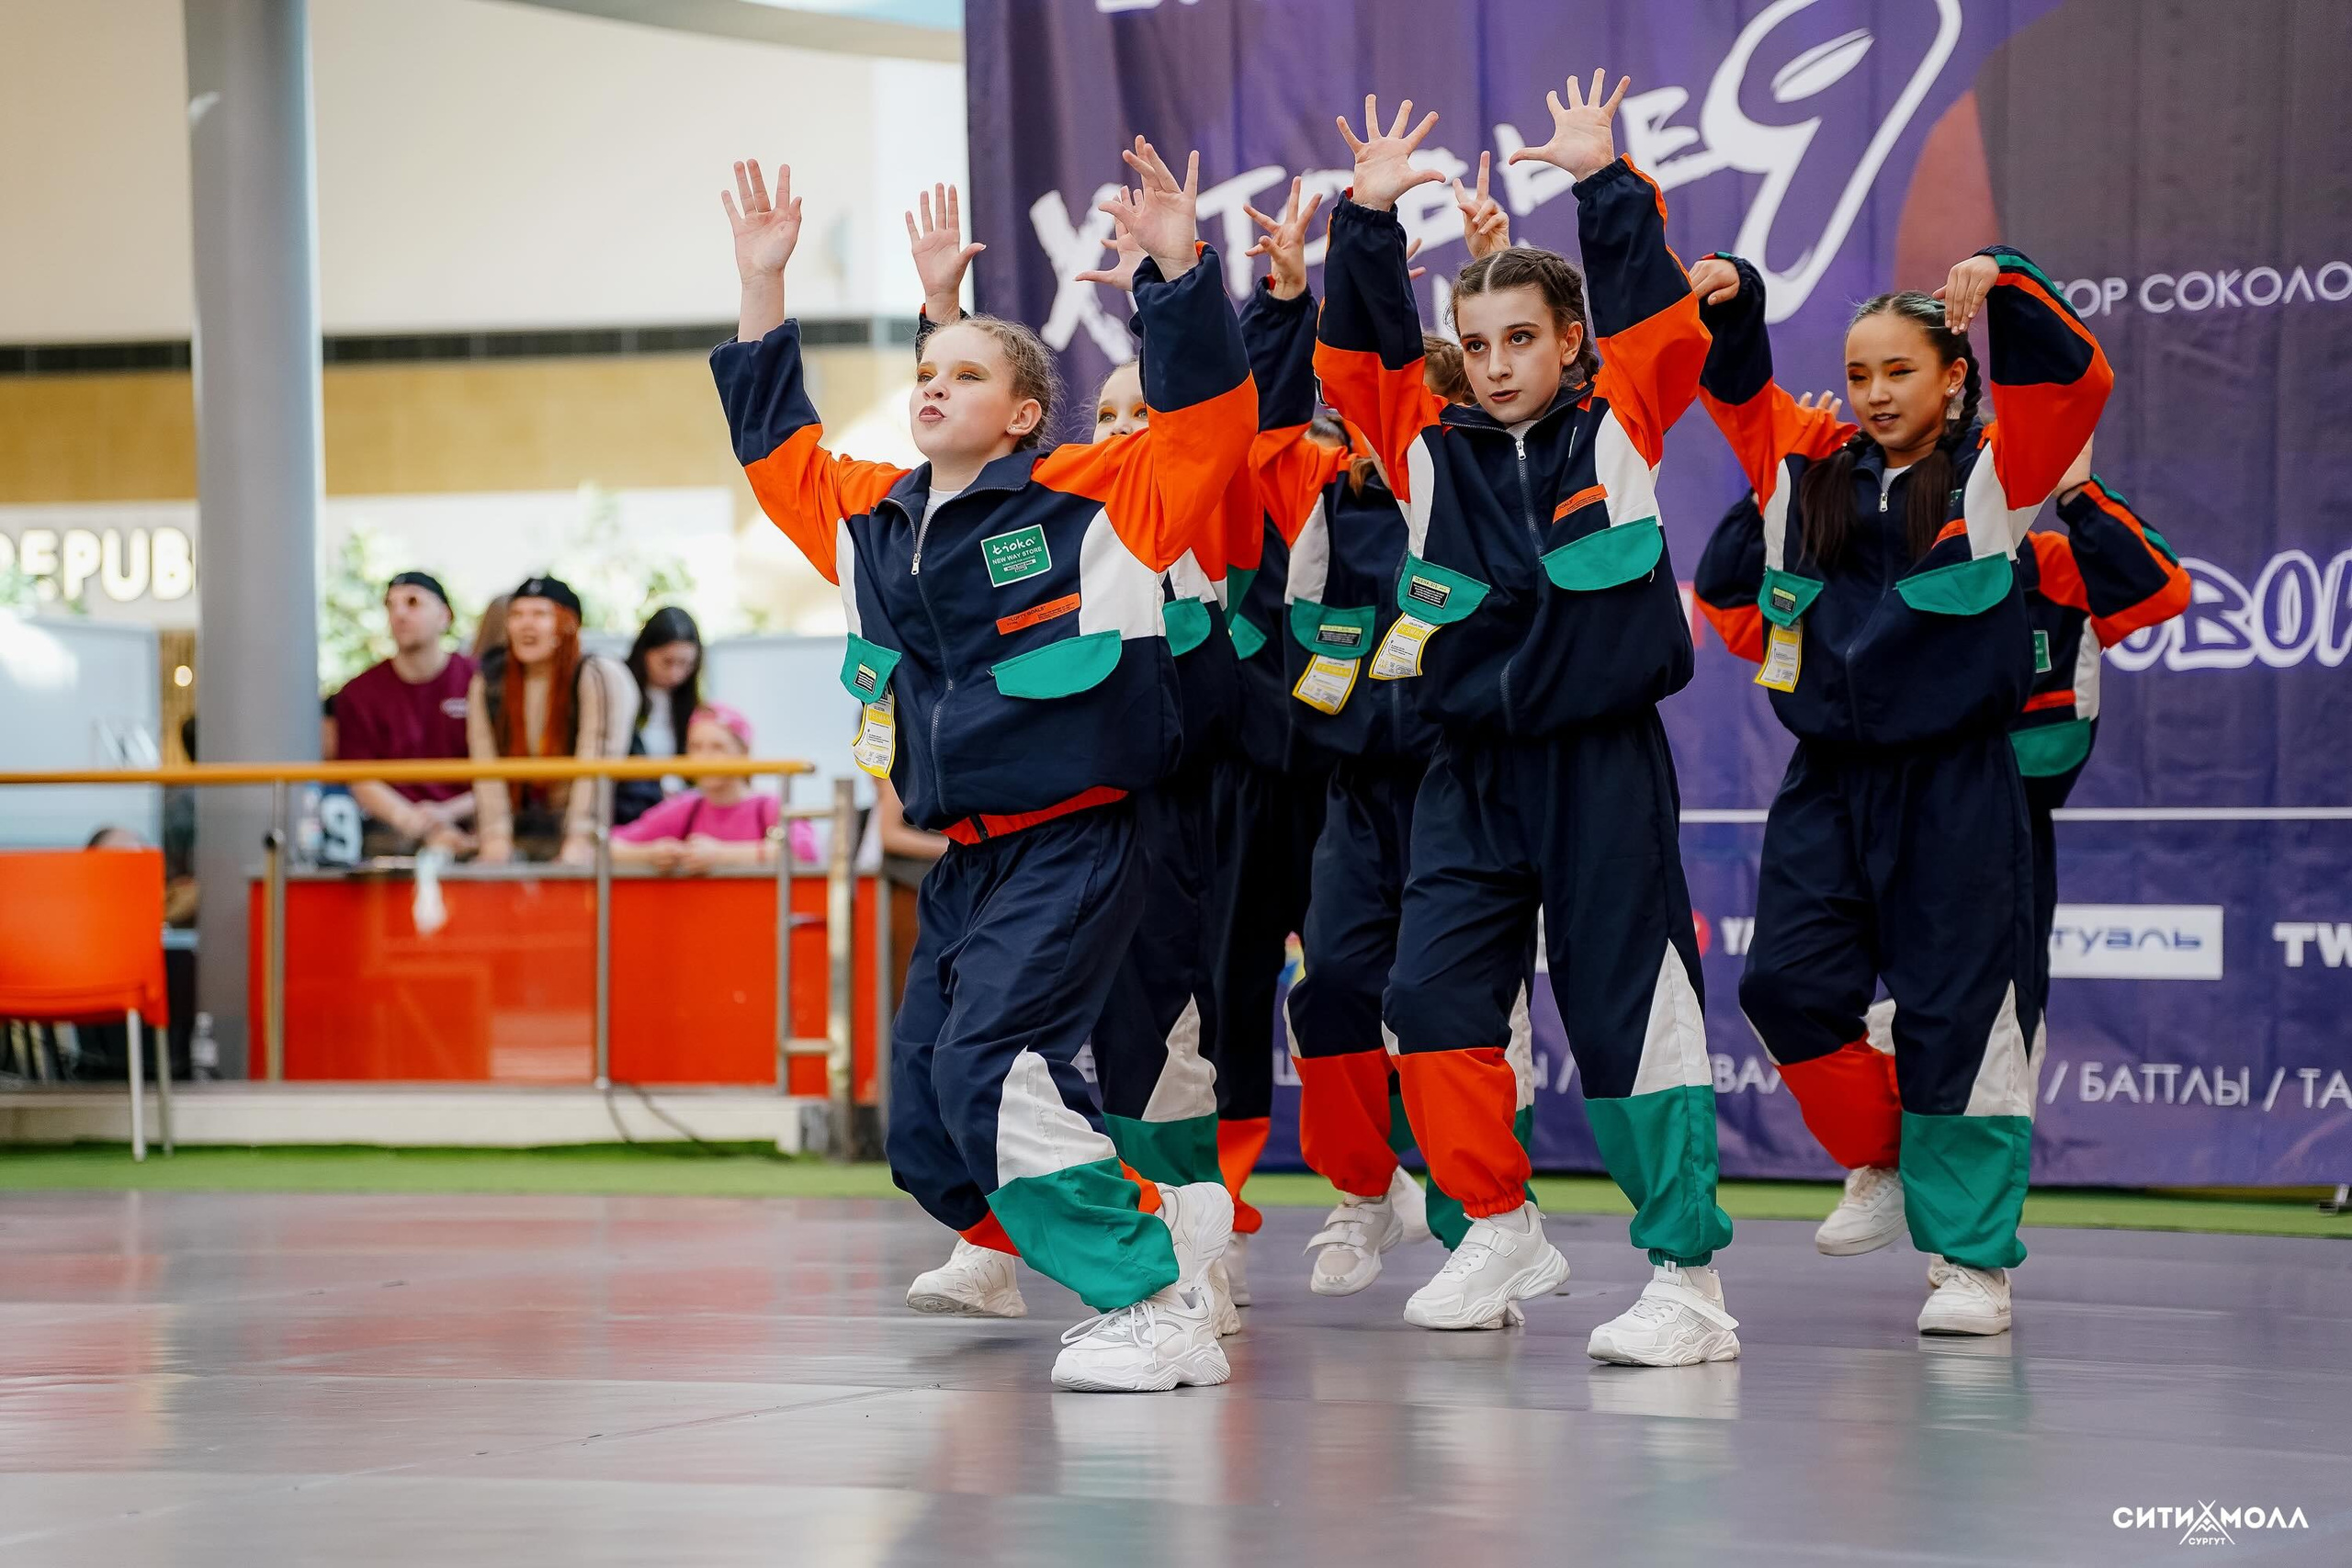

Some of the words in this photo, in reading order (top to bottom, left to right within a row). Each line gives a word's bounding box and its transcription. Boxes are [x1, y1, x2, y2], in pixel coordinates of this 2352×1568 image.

[2054, 276, 2129, 319] ОР
[2139, 261, 2352, 314] СОКОЛО
[0, 526, 196, 602] EPUB
[992, 557, 1007, 566] NEW
[1007, 553, 1022, 561] WAY
[1022, 546, 1043, 557] STORE
